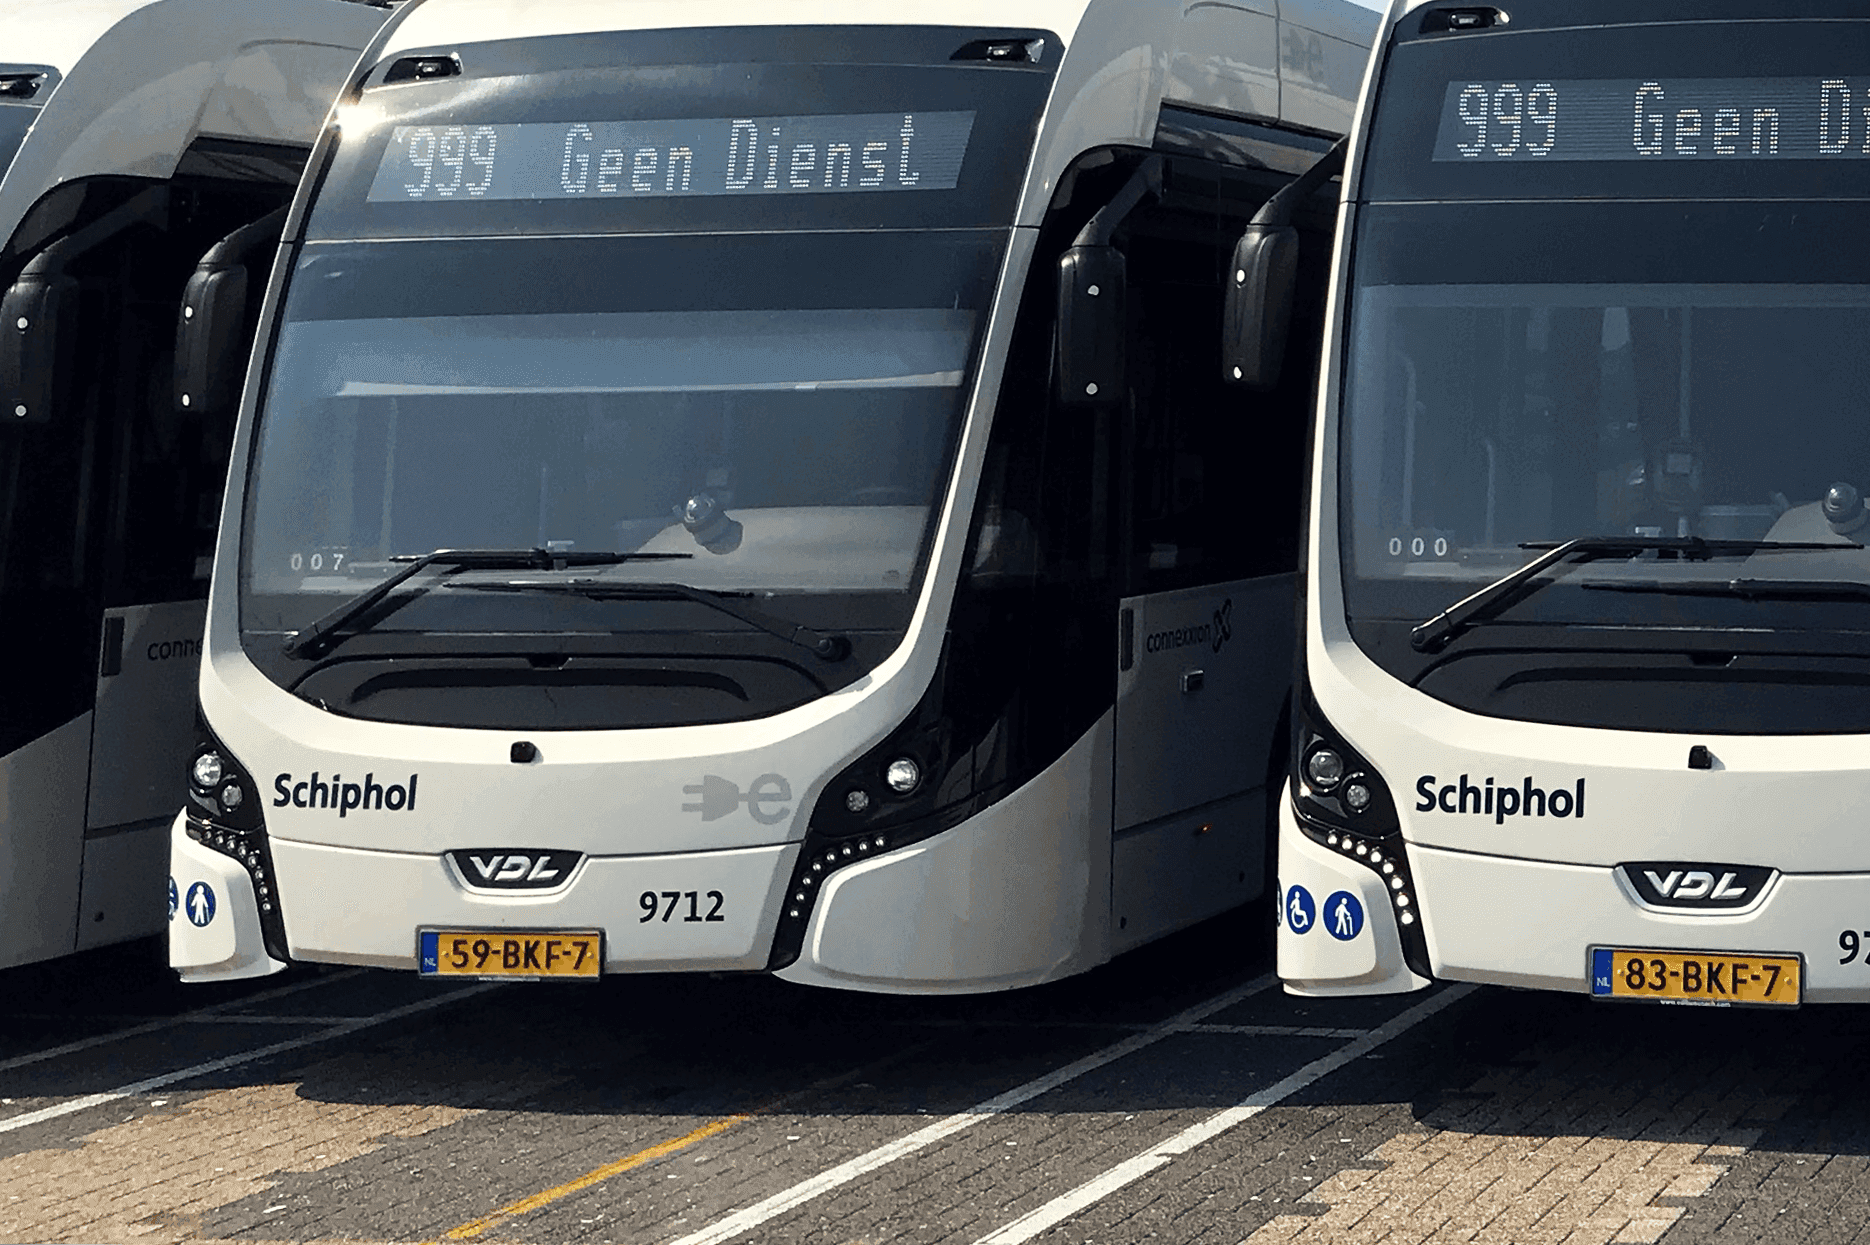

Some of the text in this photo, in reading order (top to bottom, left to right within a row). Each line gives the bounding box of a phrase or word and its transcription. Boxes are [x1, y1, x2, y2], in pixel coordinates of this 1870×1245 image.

[1455, 82, 1559, 157] 999
[1632, 81, 1781, 155] Geen
[403, 114, 921, 197] 999 Geen Dienst
[273, 771, 418, 818] Schiphol
[1415, 773, 1586, 825] Schiphol
[467, 854, 560, 882] VDL
[1642, 870, 1748, 900] VDL
[639, 890, 725, 924] 9712
[424, 939, 590, 970] NL 59-BKF-7
[1596, 957, 1782, 997] NL 83-BKF-7
